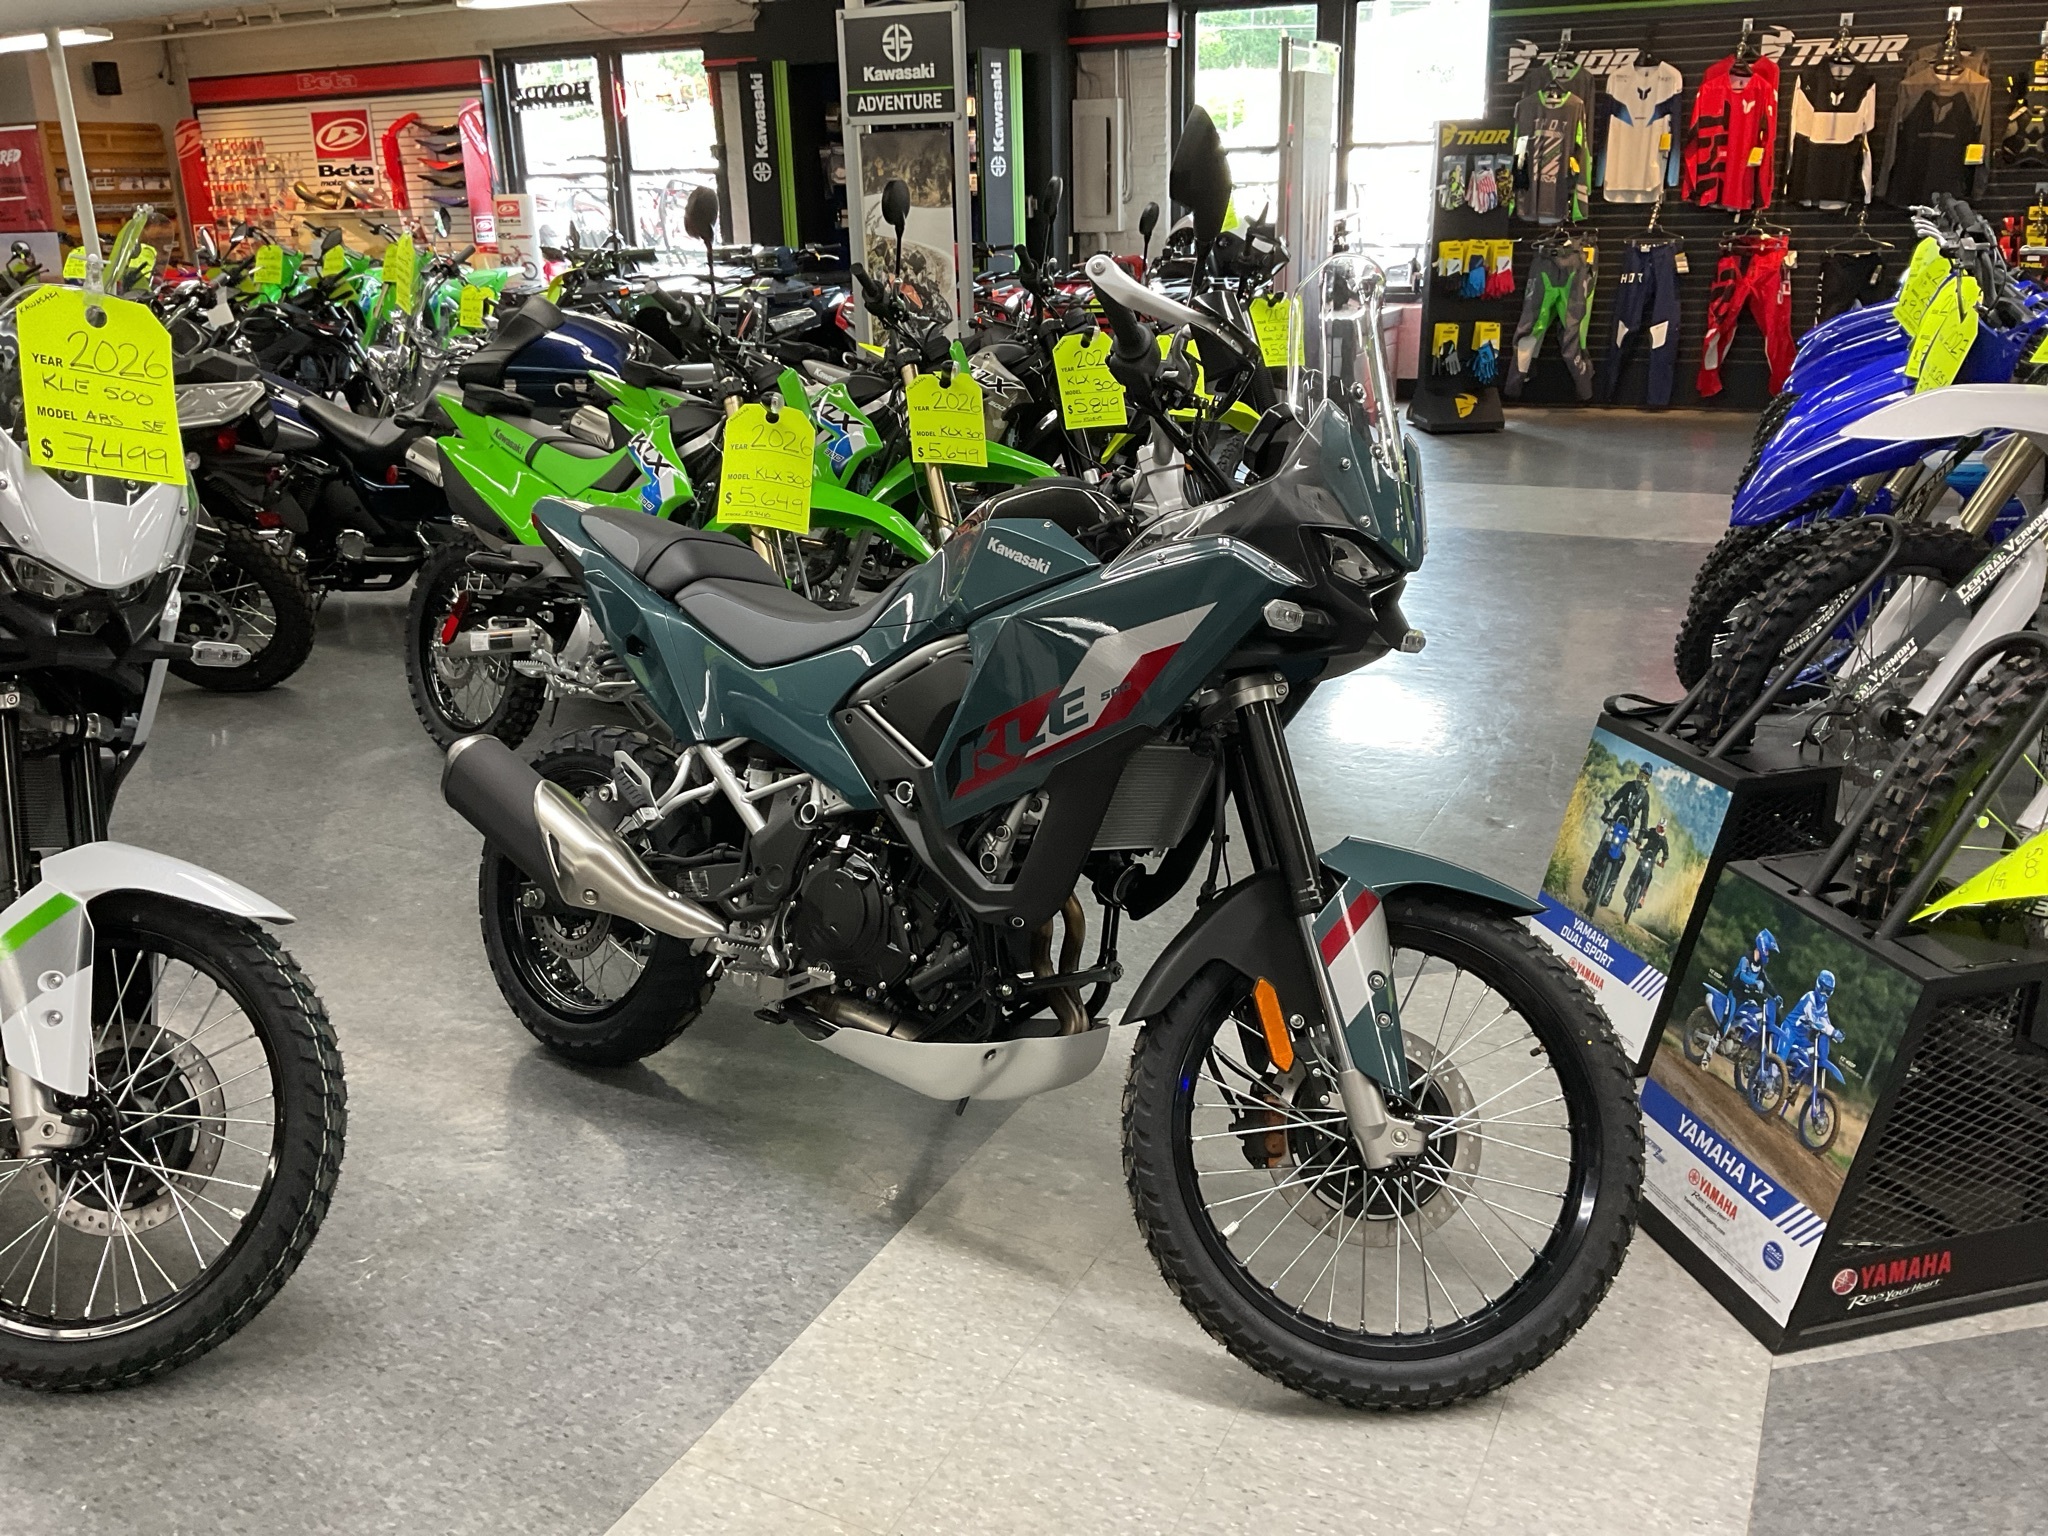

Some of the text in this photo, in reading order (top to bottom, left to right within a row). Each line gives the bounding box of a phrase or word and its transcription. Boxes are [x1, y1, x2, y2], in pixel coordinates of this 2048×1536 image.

[863, 63, 935, 82] Kawasaki
[750, 73, 768, 158] Kawasaki
[857, 93, 943, 112] ADVENTURE
[991, 62, 1004, 152] Kawasaki
[1457, 130, 1510, 145] THOR
[318, 164, 374, 177] Beta
[32, 331, 168, 379] YEAR 2026
[1074, 350, 1106, 368] 202
[42, 372, 153, 406] KLE 500
[1066, 375, 1120, 391] KLX 300
[931, 391, 981, 413] 2026
[1068, 405, 1073, 414] $
[36, 406, 166, 432] MODEL ABS SE
[940, 425, 962, 437] KLX
[966, 428, 984, 441] 300
[41, 437, 53, 460] $
[493, 427, 525, 455] Kawasaki
[627, 430, 676, 476] KLX
[751, 424, 812, 456] 2026
[918, 447, 924, 457] $
[755, 466, 783, 481] KLX
[787, 471, 811, 488] 300
[725, 492, 732, 504] $
[987, 536, 1052, 575] Kawasaki
[1956, 552, 2007, 599] CENTRAL
[1868, 637, 1916, 681] VERMONT
[960, 686, 1088, 779] KLE
[1560, 925, 1615, 968] DUAL SPORT
[1573, 917, 1610, 951] YAMAHA
[1576, 962, 1605, 990] YAMAHA
[1678, 1113, 1746, 1184] YAMAHA
[1748, 1172, 1774, 1205] YZ
[1700, 1177, 1738, 1220] YAMAHA
[1861, 1251, 1951, 1290] YAMAHA
[1847, 1278, 1941, 1310] Revs Your Heart
